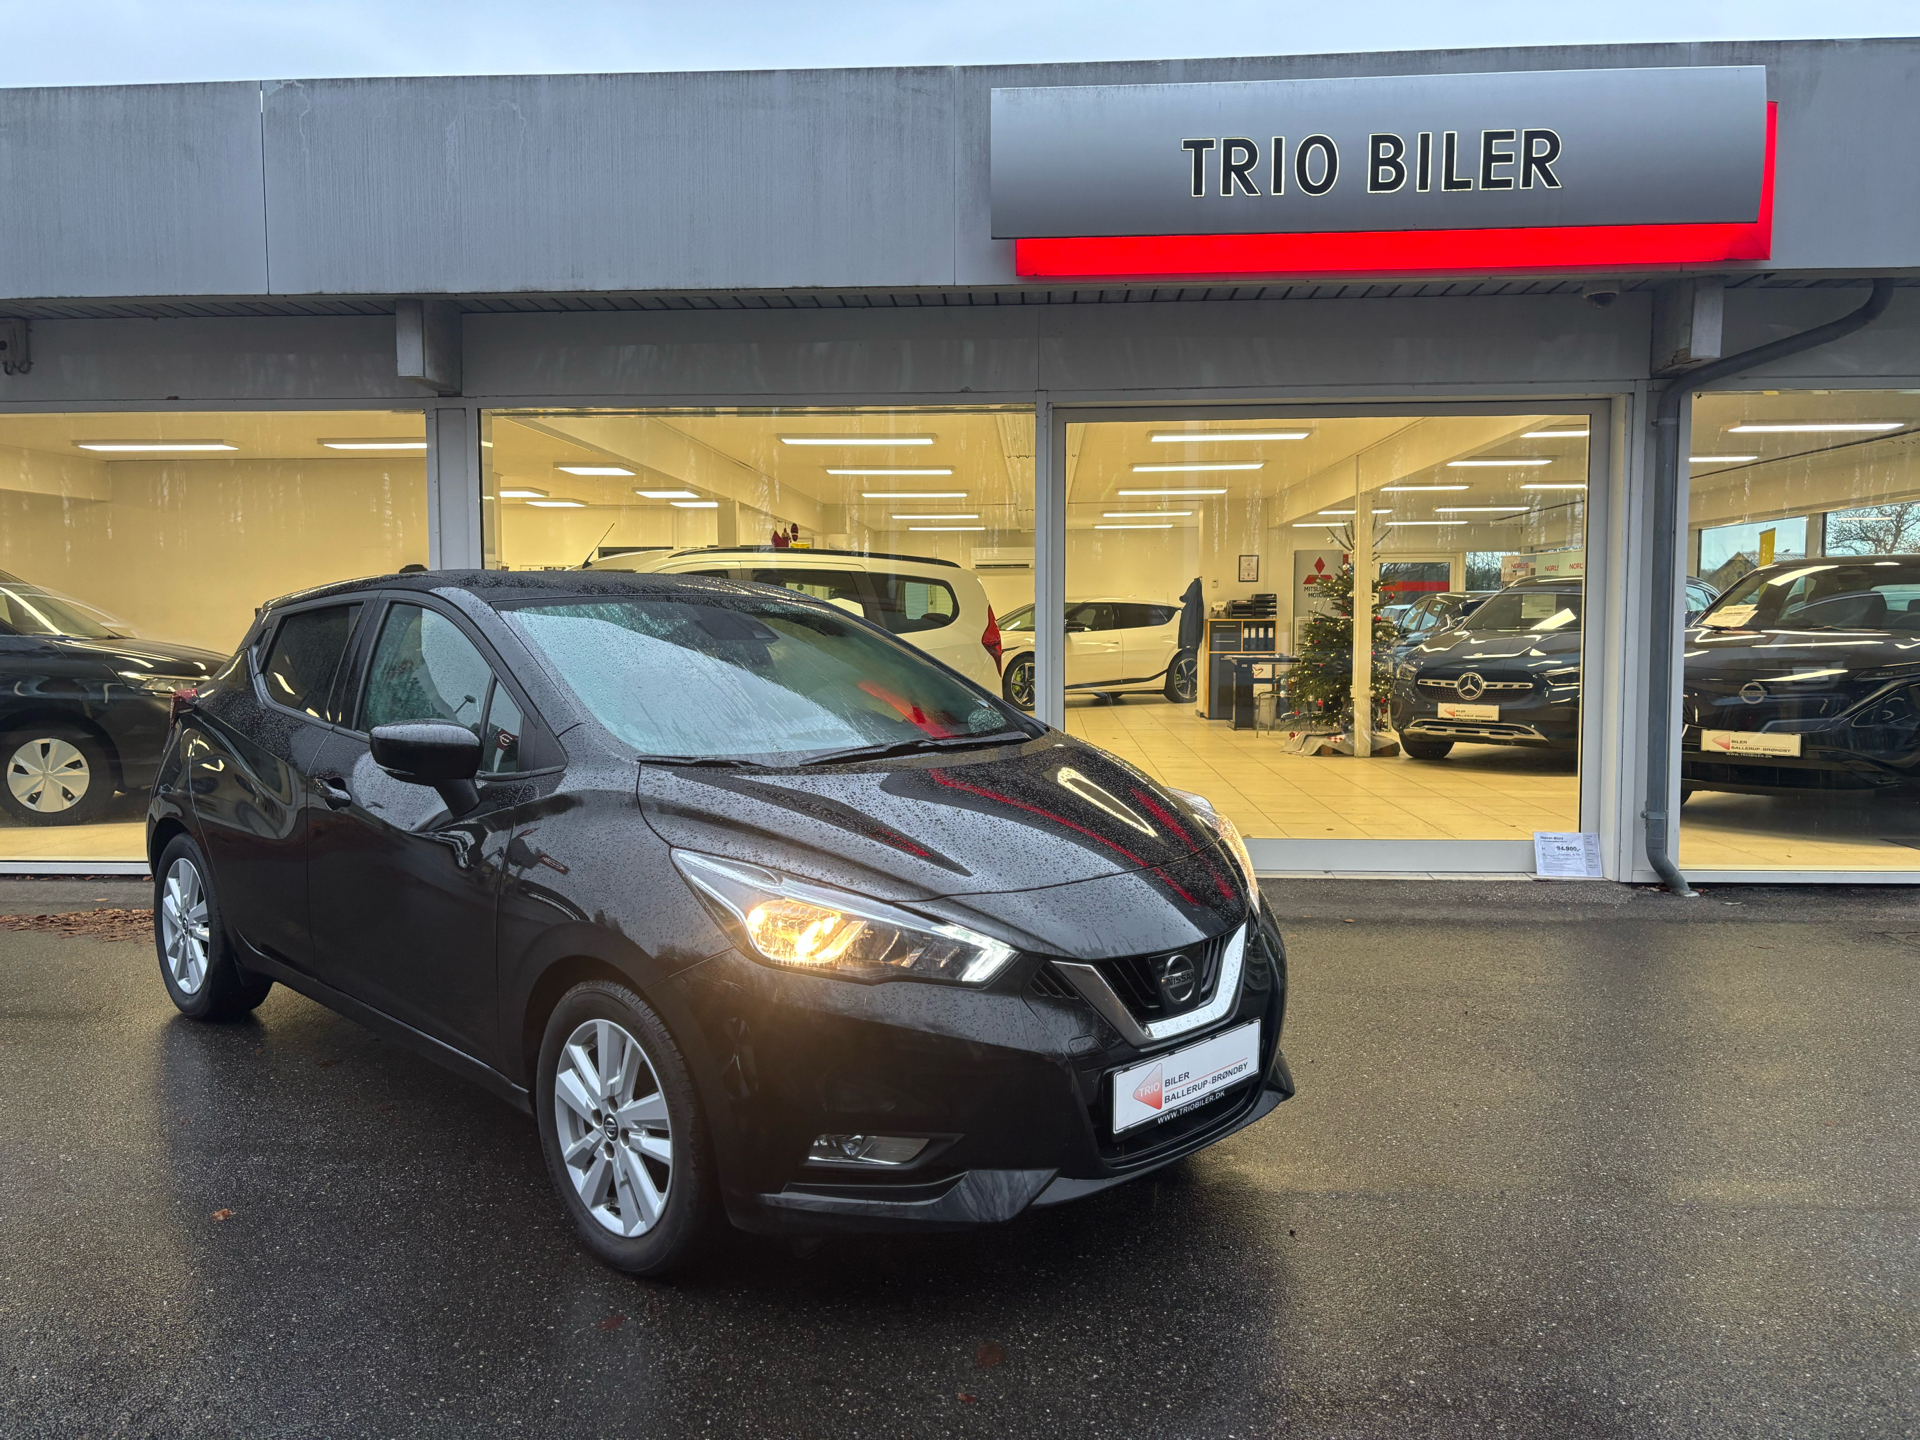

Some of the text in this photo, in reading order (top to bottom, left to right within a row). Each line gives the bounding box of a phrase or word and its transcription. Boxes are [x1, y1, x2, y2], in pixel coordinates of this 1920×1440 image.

[1181, 128, 1562, 197] TRIO BILER
[1139, 1082, 1161, 1098] TRIO
[1164, 1071, 1190, 1088] BILER
[1157, 1090, 1226, 1125] WWW.TRIOBILER.DK
